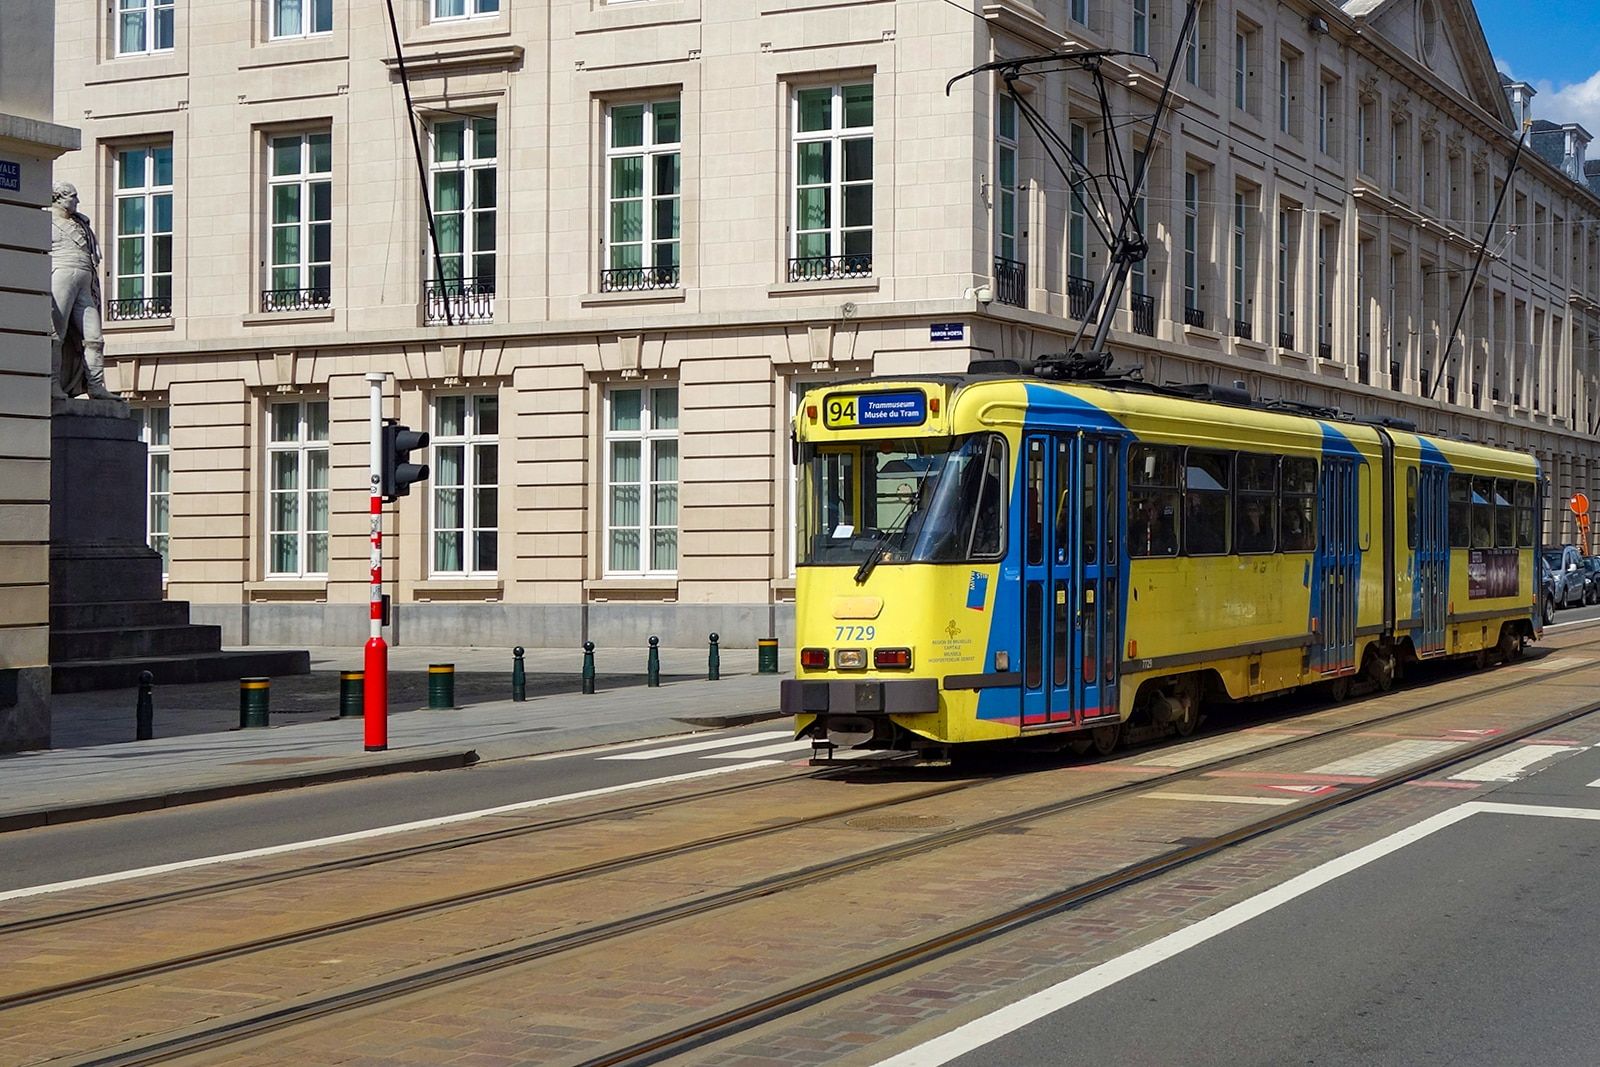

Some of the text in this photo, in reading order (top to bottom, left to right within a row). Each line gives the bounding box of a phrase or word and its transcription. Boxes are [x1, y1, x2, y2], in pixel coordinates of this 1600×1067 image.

[868, 401, 915, 409] Trammuseum
[830, 401, 856, 422] 94
[864, 409, 919, 419] Musée du Tram
[835, 625, 876, 641] 7729
[1142, 658, 1153, 669] 7729
